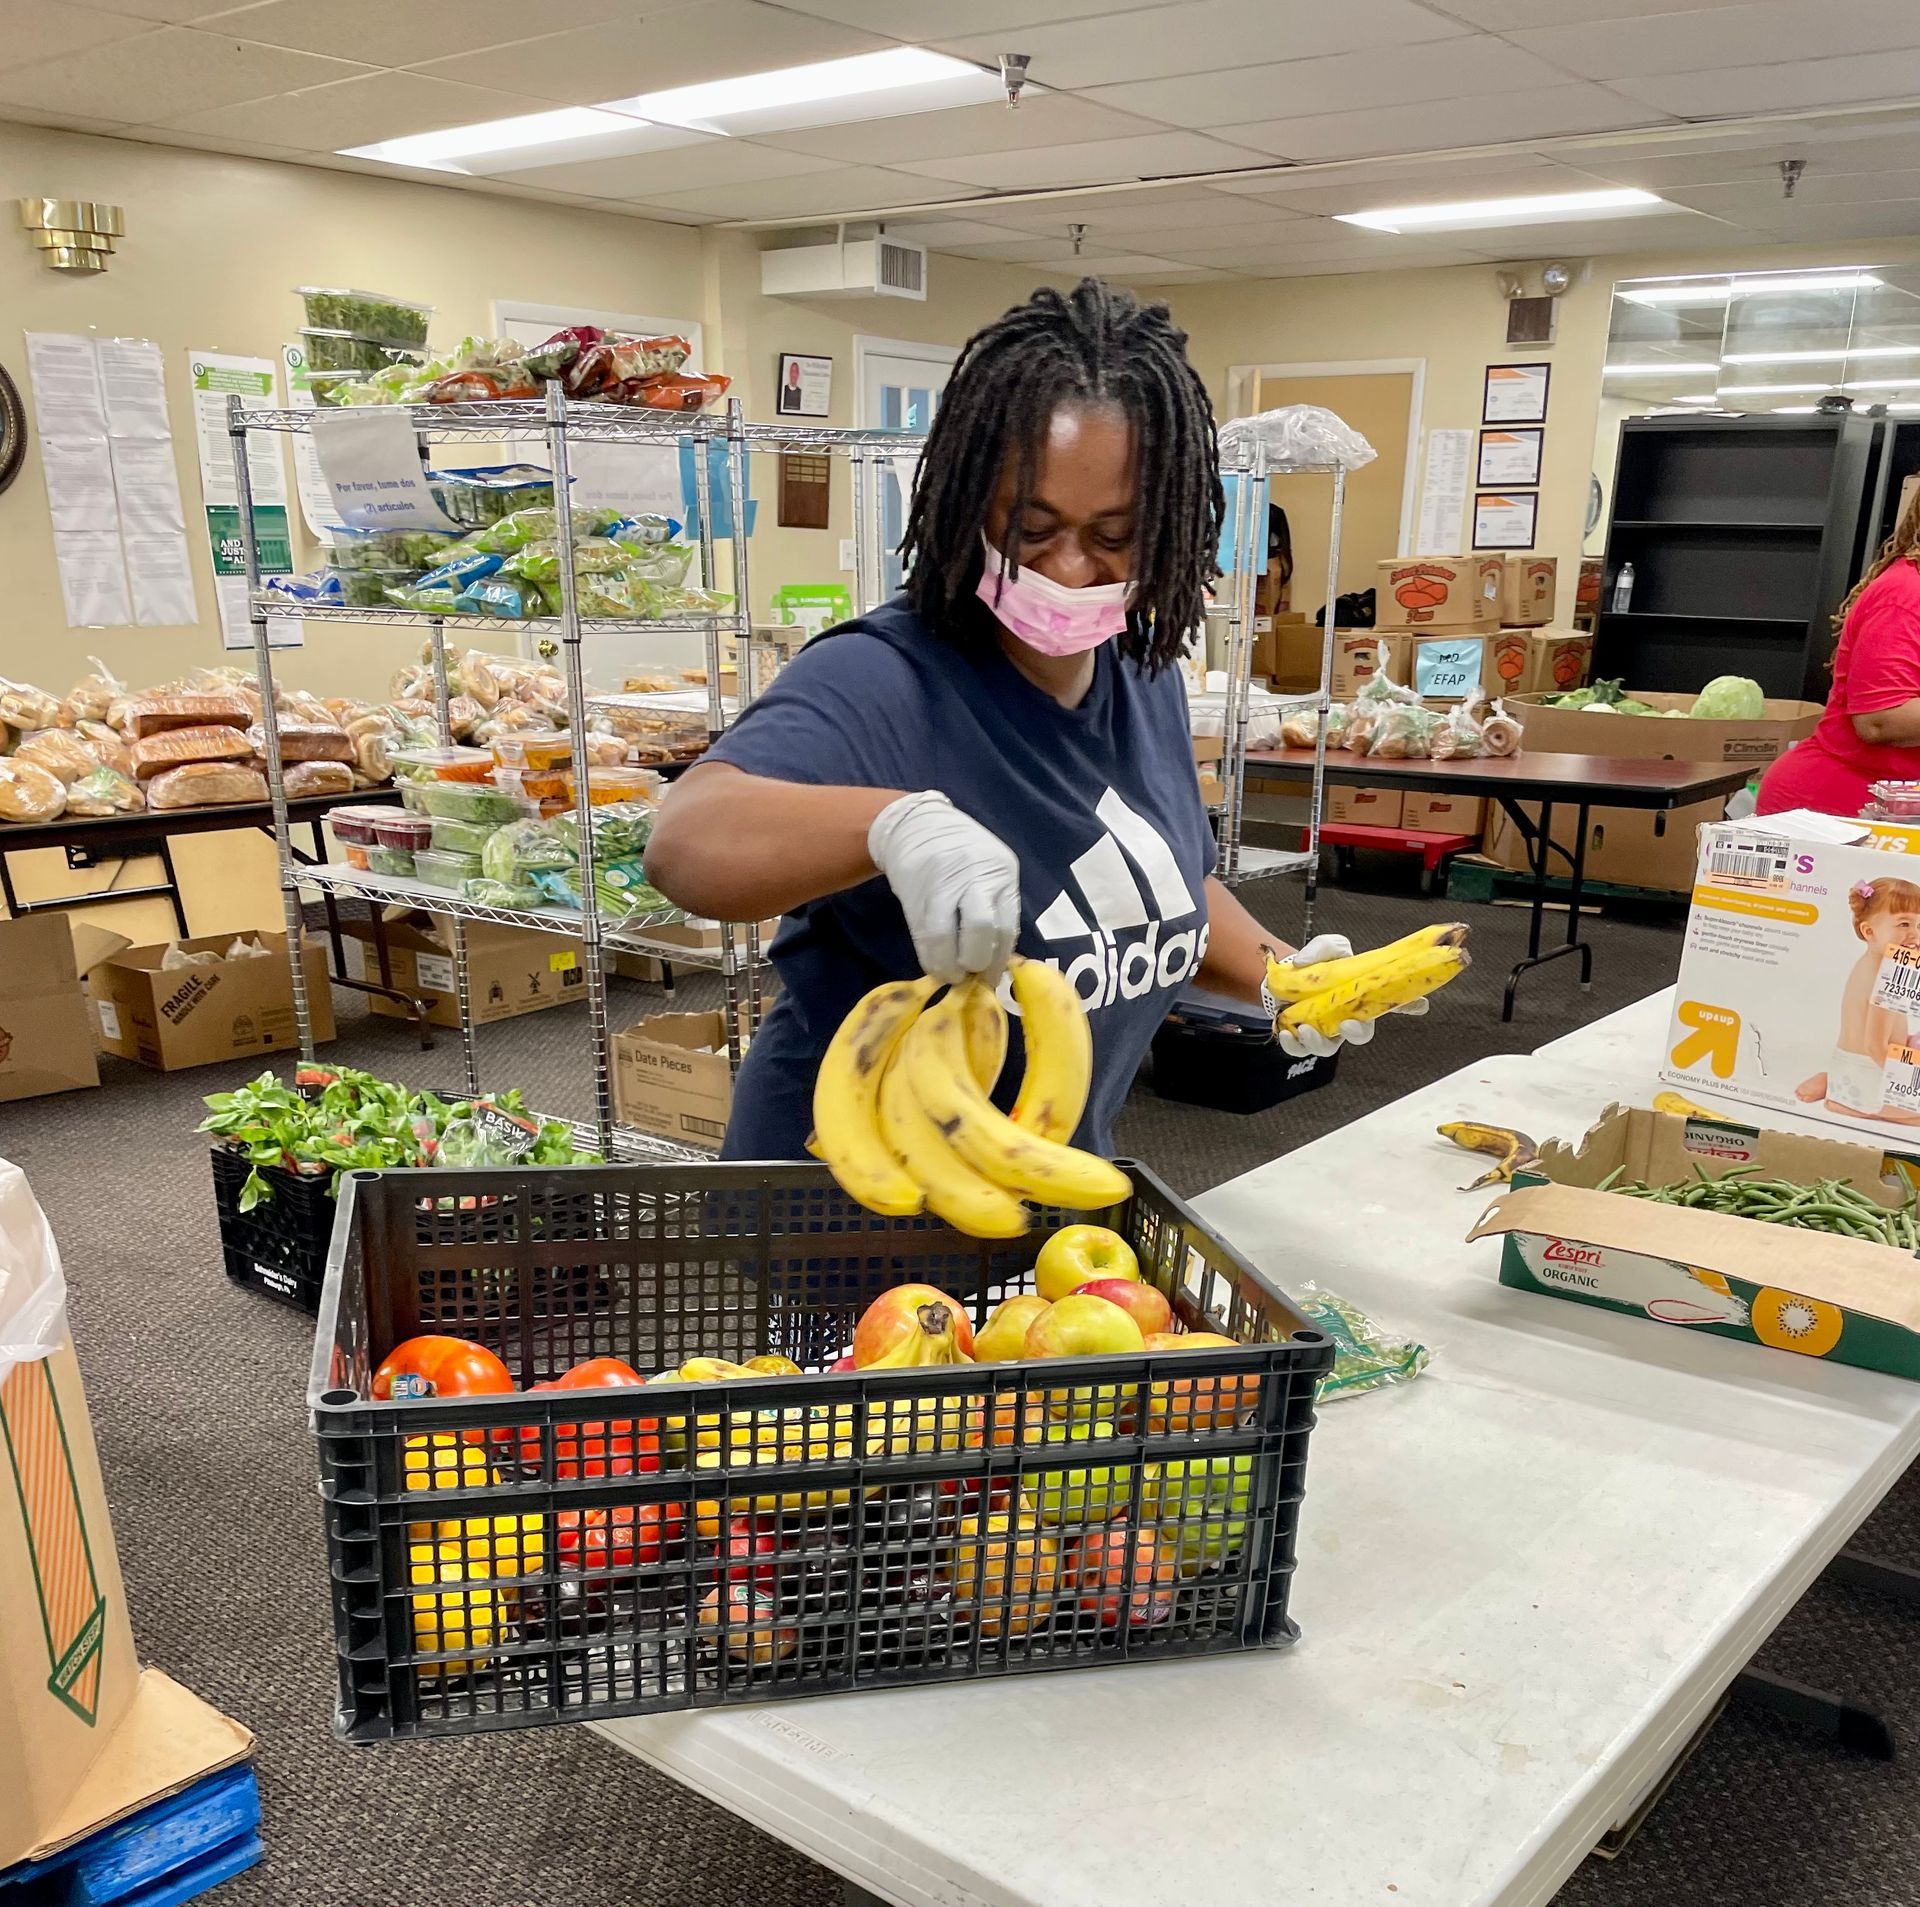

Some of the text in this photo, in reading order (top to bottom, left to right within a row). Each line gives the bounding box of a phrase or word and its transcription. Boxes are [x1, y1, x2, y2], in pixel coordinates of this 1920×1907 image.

[336, 482, 351, 493] Por
[352, 480, 378, 492] favor,
[400, 478, 416, 488] dos
[220, 540, 241, 548] AND
[234, 556, 246, 564] AL
[1790, 880, 1828, 896] hannels
[161, 974, 203, 1018] FRAGILE
[635, 1050, 693, 1074] Date Pieces
[1900, 1048, 1913, 1066] ML
[1667, 1070, 1738, 1093] ECONOMY PLUS PACK
[1889, 1081, 1920, 1097] 74005
[485, 1111, 526, 1140] BASIL
[1543, 1236, 1603, 1267] Zespri
[1542, 1267, 1599, 1289] ORGANIC
